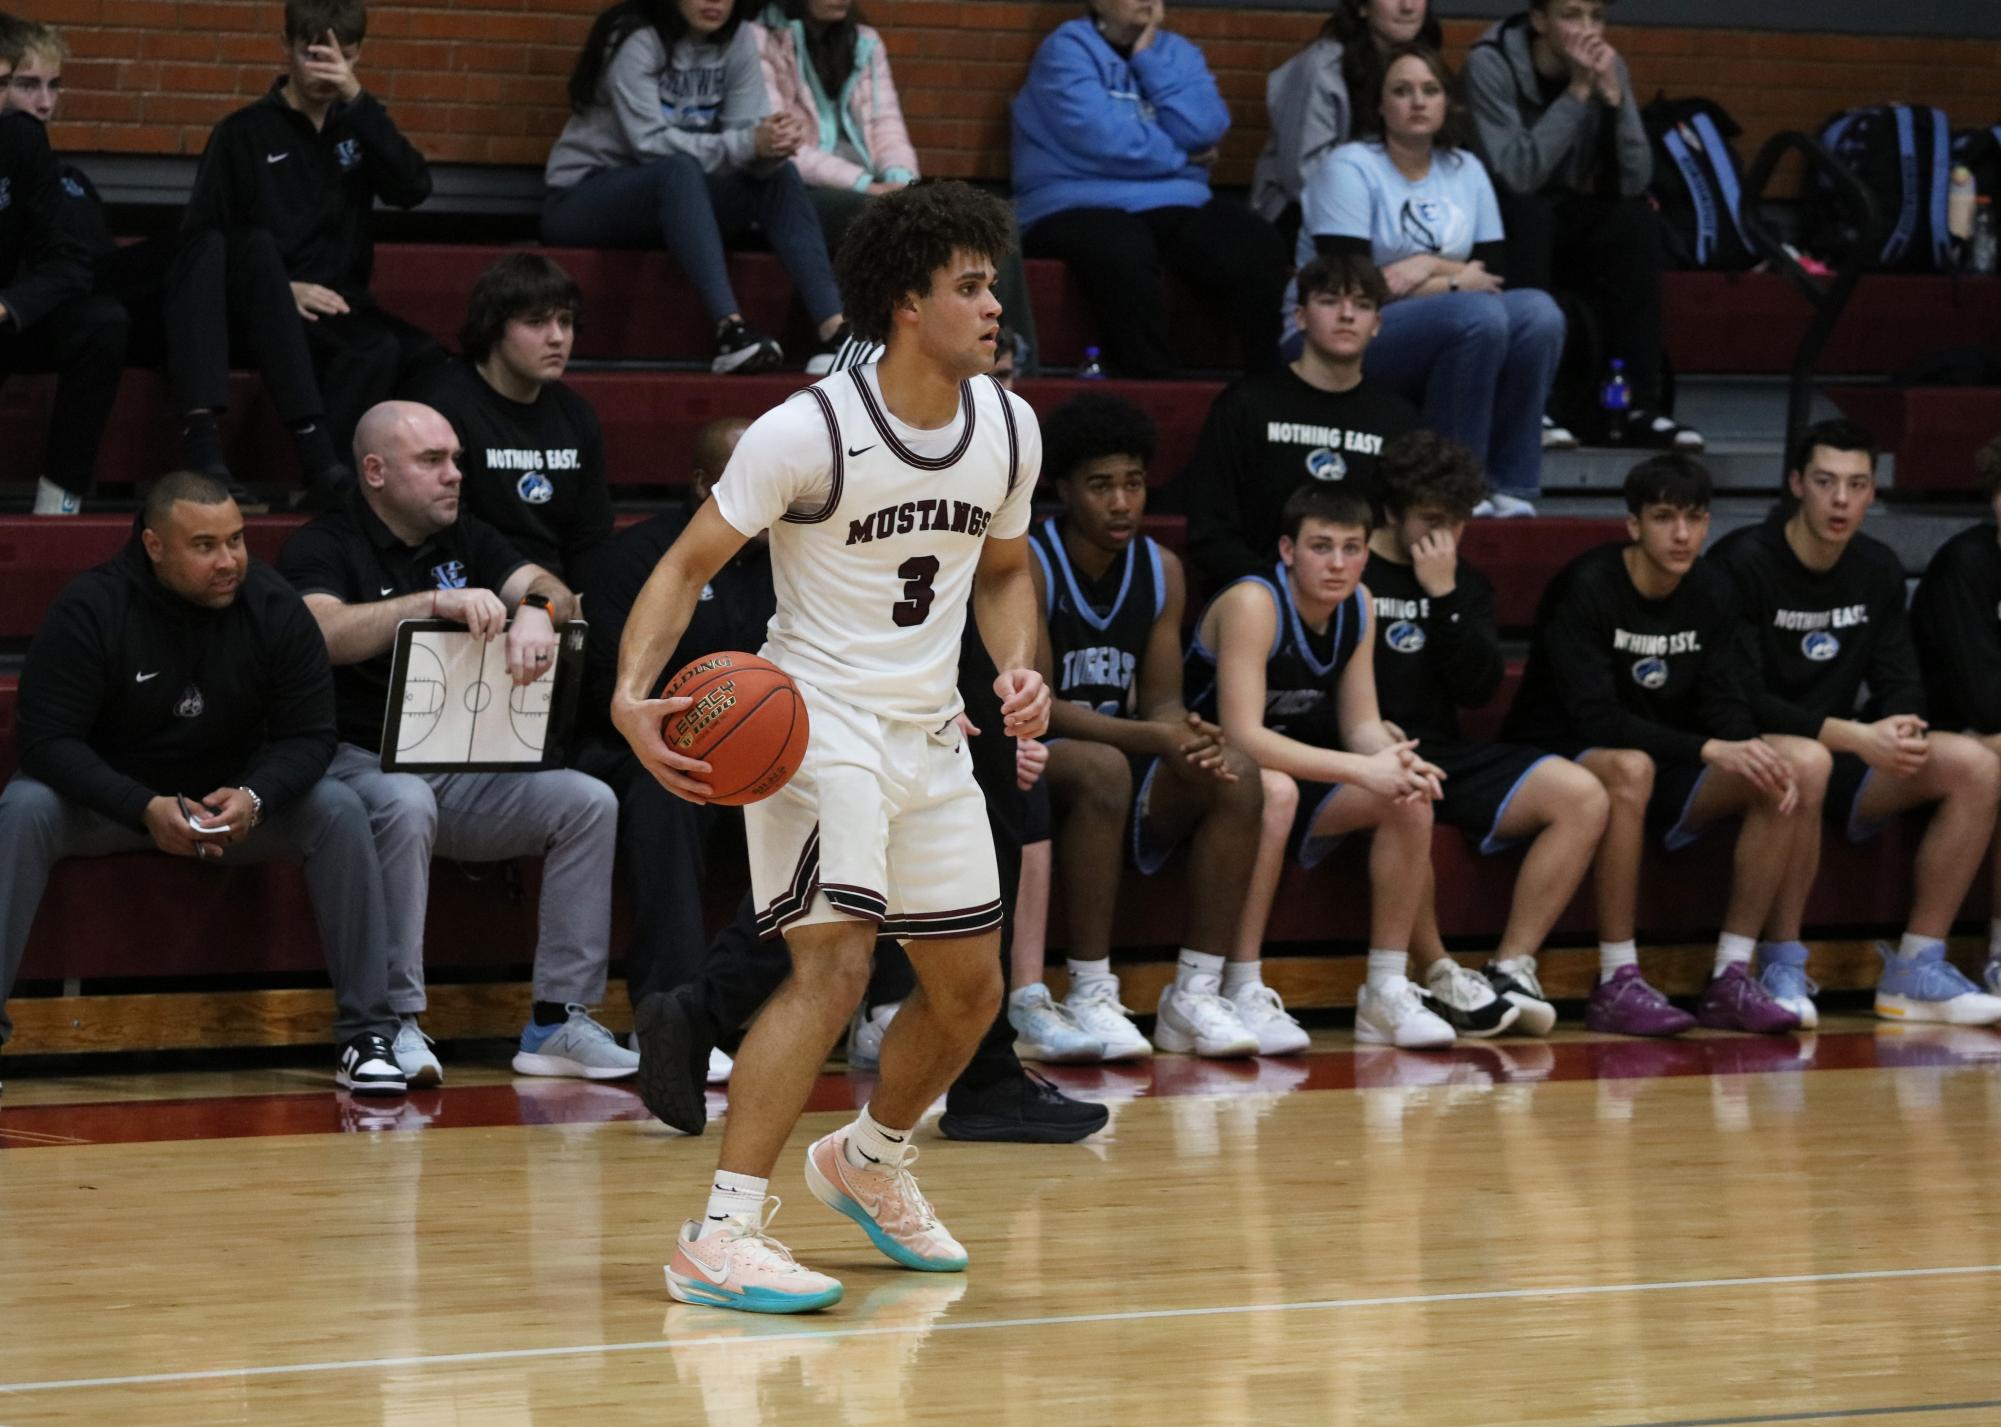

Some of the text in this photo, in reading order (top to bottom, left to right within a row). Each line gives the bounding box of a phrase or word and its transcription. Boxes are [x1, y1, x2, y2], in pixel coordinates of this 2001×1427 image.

[1267, 421, 1342, 449] NOTHING
[845, 499, 992, 547] MUSTANGS
[892, 554, 940, 628] 3
[1373, 597, 1417, 619] THING
[1614, 627, 1668, 656] NTHING
[667, 655, 734, 699] LDING
[669, 679, 736, 747] LEGACY
[693, 695, 737, 734] 1000
